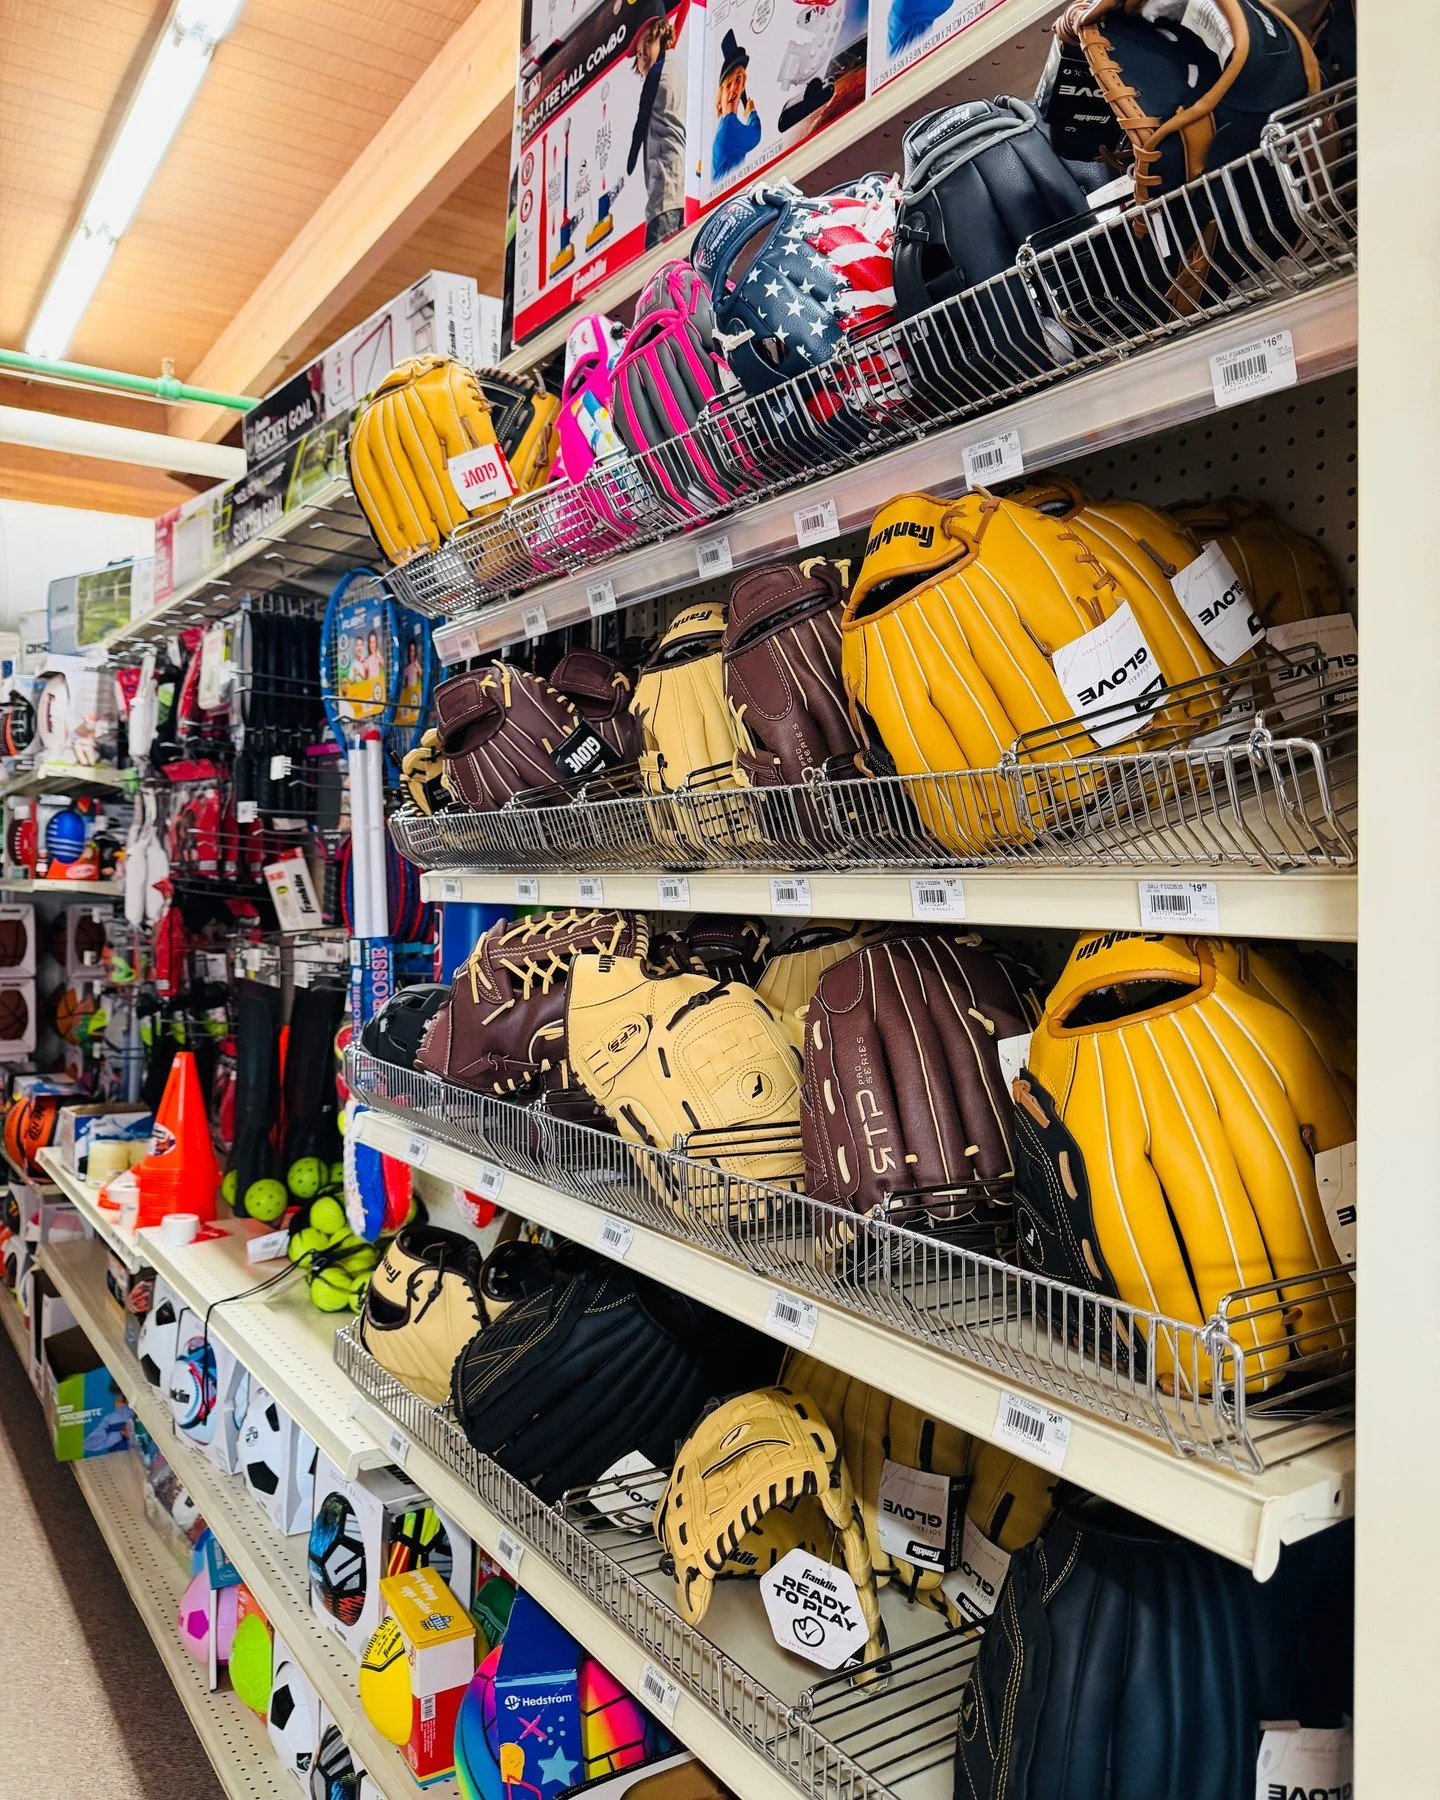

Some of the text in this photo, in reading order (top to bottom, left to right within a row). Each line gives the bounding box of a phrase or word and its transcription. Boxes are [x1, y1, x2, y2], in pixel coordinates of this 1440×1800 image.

[544, 85, 561, 112] TEE
[560, 64, 585, 98] BALL
[586, 24, 627, 72] COMBO
[571, 257, 608, 301] Franklin
[288, 398, 314, 431] GOAL
[462, 462, 498, 488] GLOVE
[1077, 646, 1148, 707] GLOVE
[564, 735, 601, 774] GLOVE
[883, 1498, 943, 1528] GLOVE
[911, 1544, 941, 1562] Franklin
[782, 1574, 852, 1616] READY
[801, 1568, 838, 1593] Franklin
[772, 1583, 858, 1632] TO PLAY
[522, 1693, 572, 1707] Hedstrom
